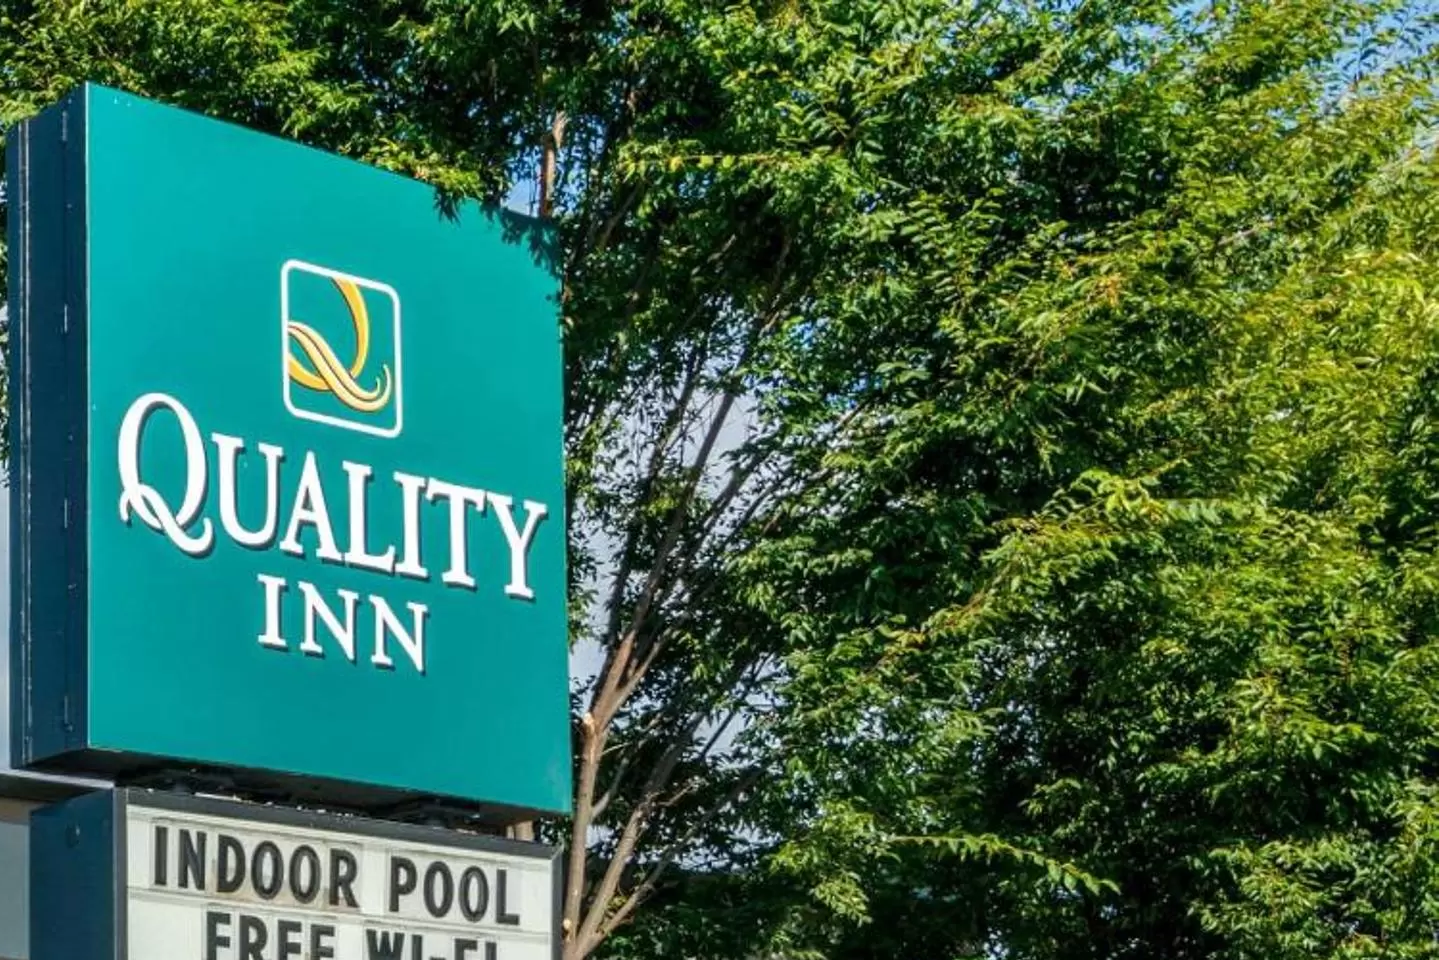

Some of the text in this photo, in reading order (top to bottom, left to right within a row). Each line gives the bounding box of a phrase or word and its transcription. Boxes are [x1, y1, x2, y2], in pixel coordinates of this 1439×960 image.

[117, 392, 547, 600] QUALITY
[257, 573, 428, 674] INN
[155, 826, 521, 926] INDOOR POOL
